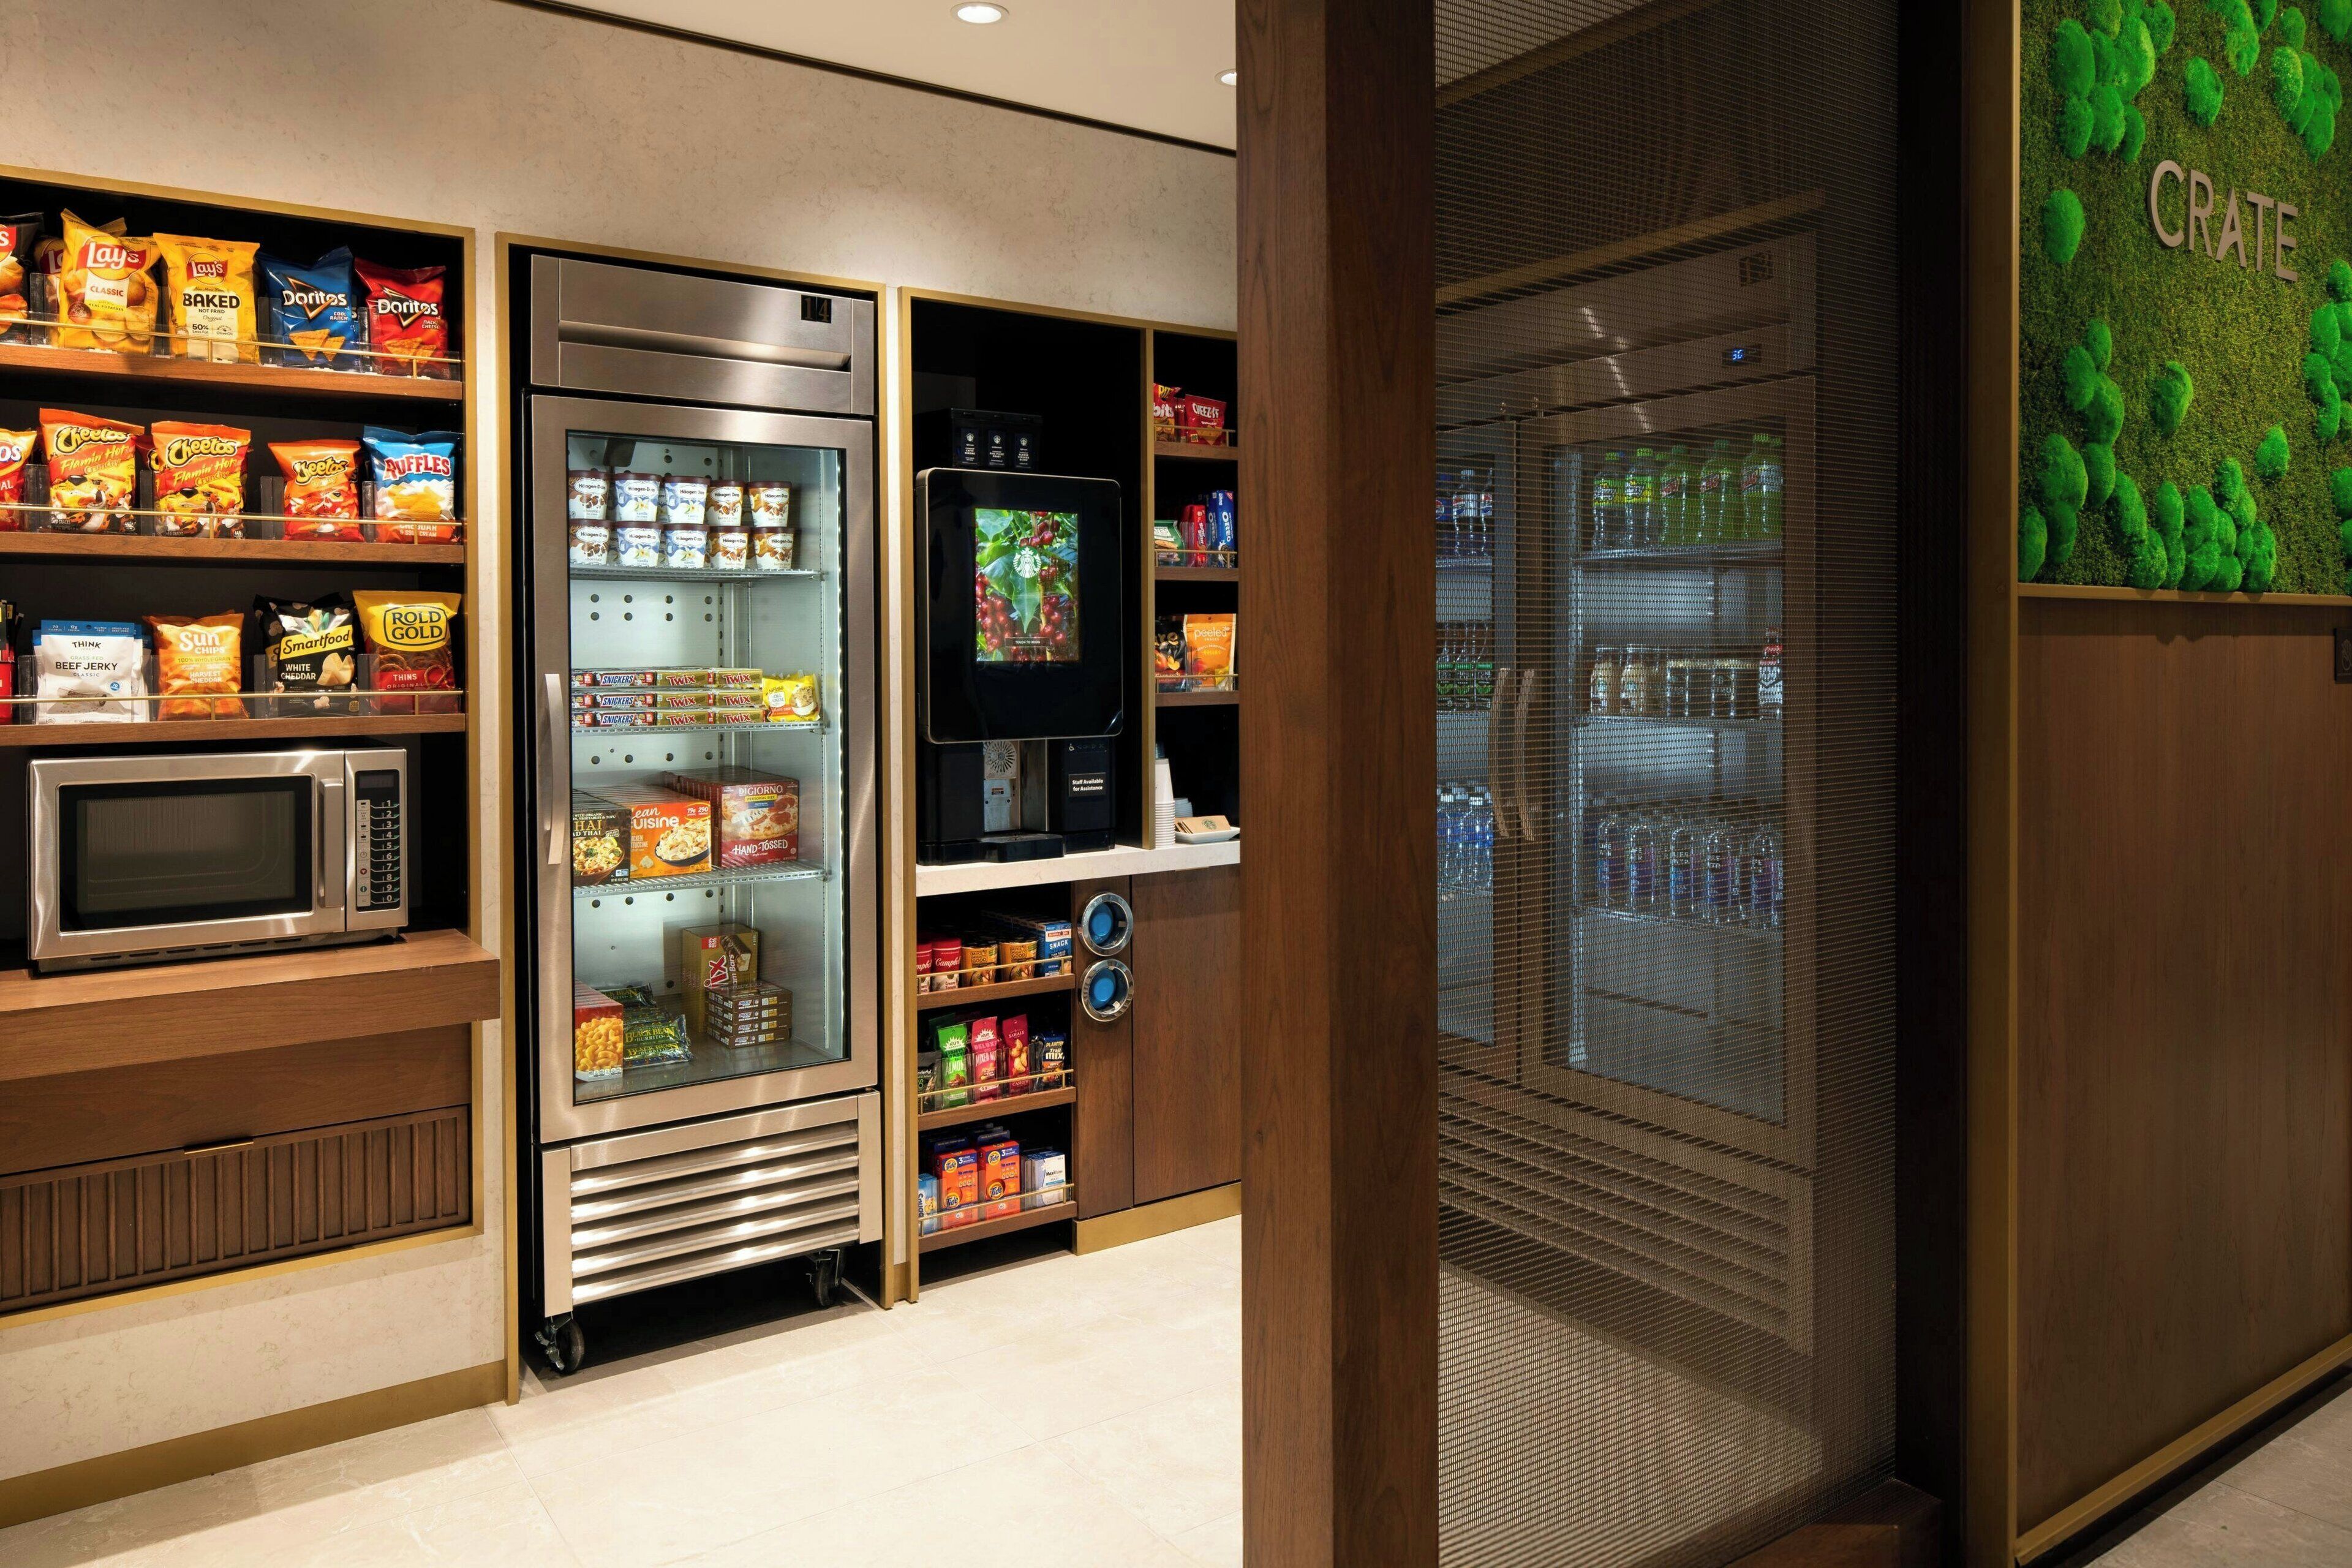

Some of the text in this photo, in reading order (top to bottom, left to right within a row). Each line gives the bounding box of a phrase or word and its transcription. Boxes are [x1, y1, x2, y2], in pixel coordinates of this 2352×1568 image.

[2148, 159, 2298, 282] CRATE
[191, 260, 224, 278] Lay's
[91, 285, 124, 296] CLASSIC
[183, 293, 241, 309] BAKED
[282, 290, 347, 306] Doritos
[378, 299, 439, 315] Doritos
[804, 297, 829, 322] 14
[56, 426, 128, 454] Cheetos
[105, 445, 129, 459] Hot
[167, 437, 237, 466] Cheetos
[213, 458, 236, 470] Hot
[293, 457, 347, 484] Cheetos
[384, 454, 451, 480] RUFFLES
[1222, 511, 1231, 542] OREO
[392, 611, 442, 625] ROLD
[392, 625, 443, 639] GOLD
[1194, 627, 1227, 641] peeled
[179, 631, 221, 652] Sun
[282, 630, 351, 655] Smartfood
[281, 673, 316, 681] CHEDDAR
[603, 675, 633, 684] SNICKERS
[603, 715, 633, 723] SNICKERS
[575, 820, 602, 831] HAI
[732, 839, 788, 856] HAND-TOSSED
[1049, 939, 1068, 949] SNACK
[625, 1027, 676, 1042] BLACK BEAN
[988, 1155, 999, 1163] Tide
[945, 1163, 956, 1171] Tide
[990, 1188, 1003, 1197] Tide
[946, 1197, 958, 1206] Tide
